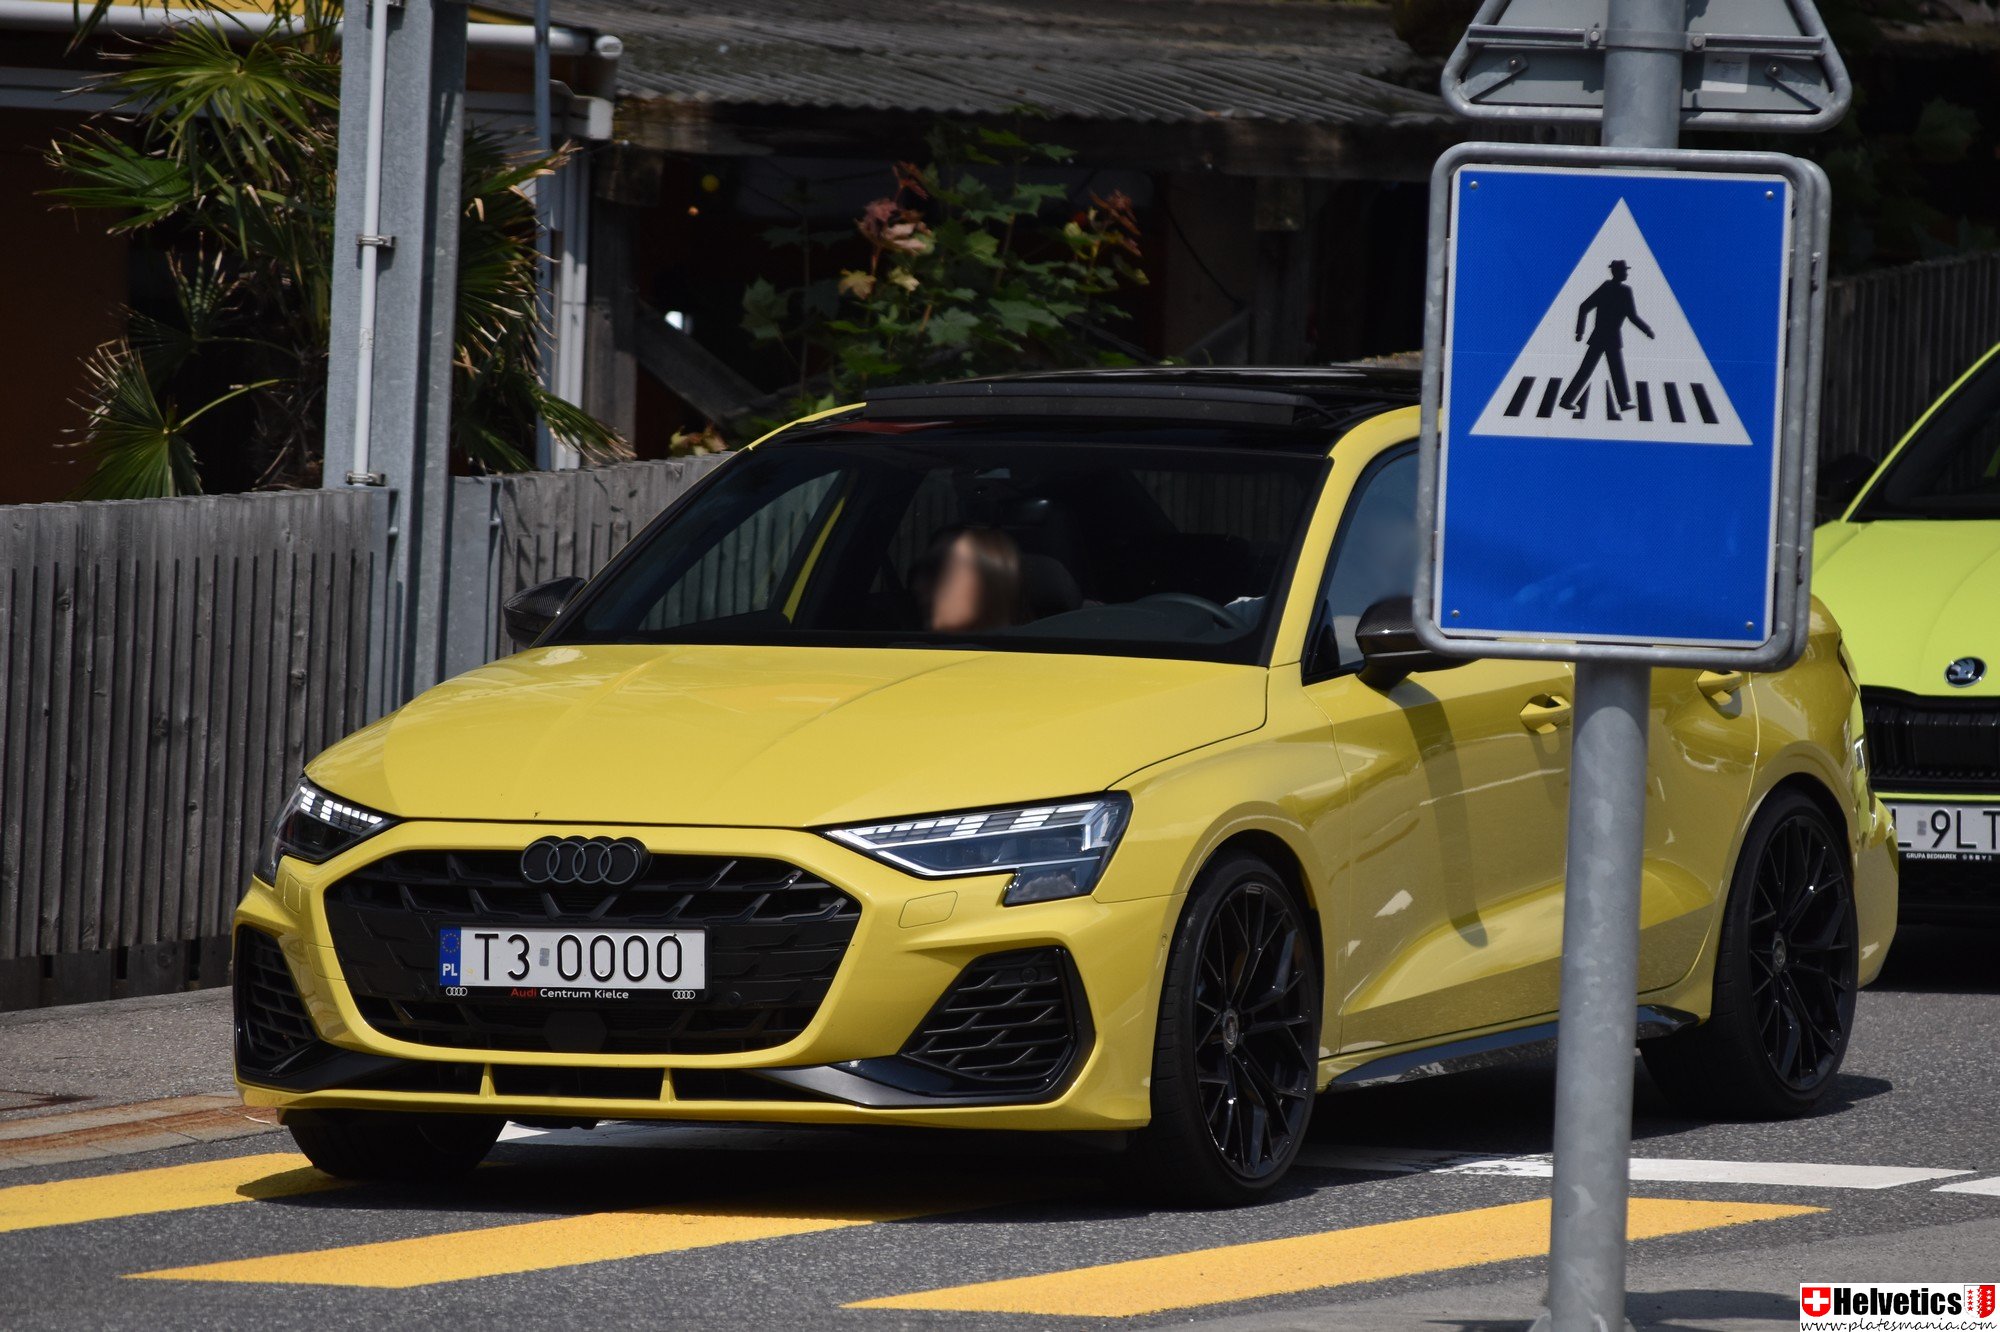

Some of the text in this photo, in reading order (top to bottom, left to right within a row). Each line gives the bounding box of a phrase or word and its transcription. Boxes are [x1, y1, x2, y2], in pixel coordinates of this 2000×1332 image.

[1931, 809, 2000, 850] 9LT
[1906, 852, 1957, 861] GRUPA BEDNAREK
[475, 933, 683, 983] T3 0000
[442, 963, 458, 977] PL
[510, 987, 630, 1000] Audi Centrum Kielce
